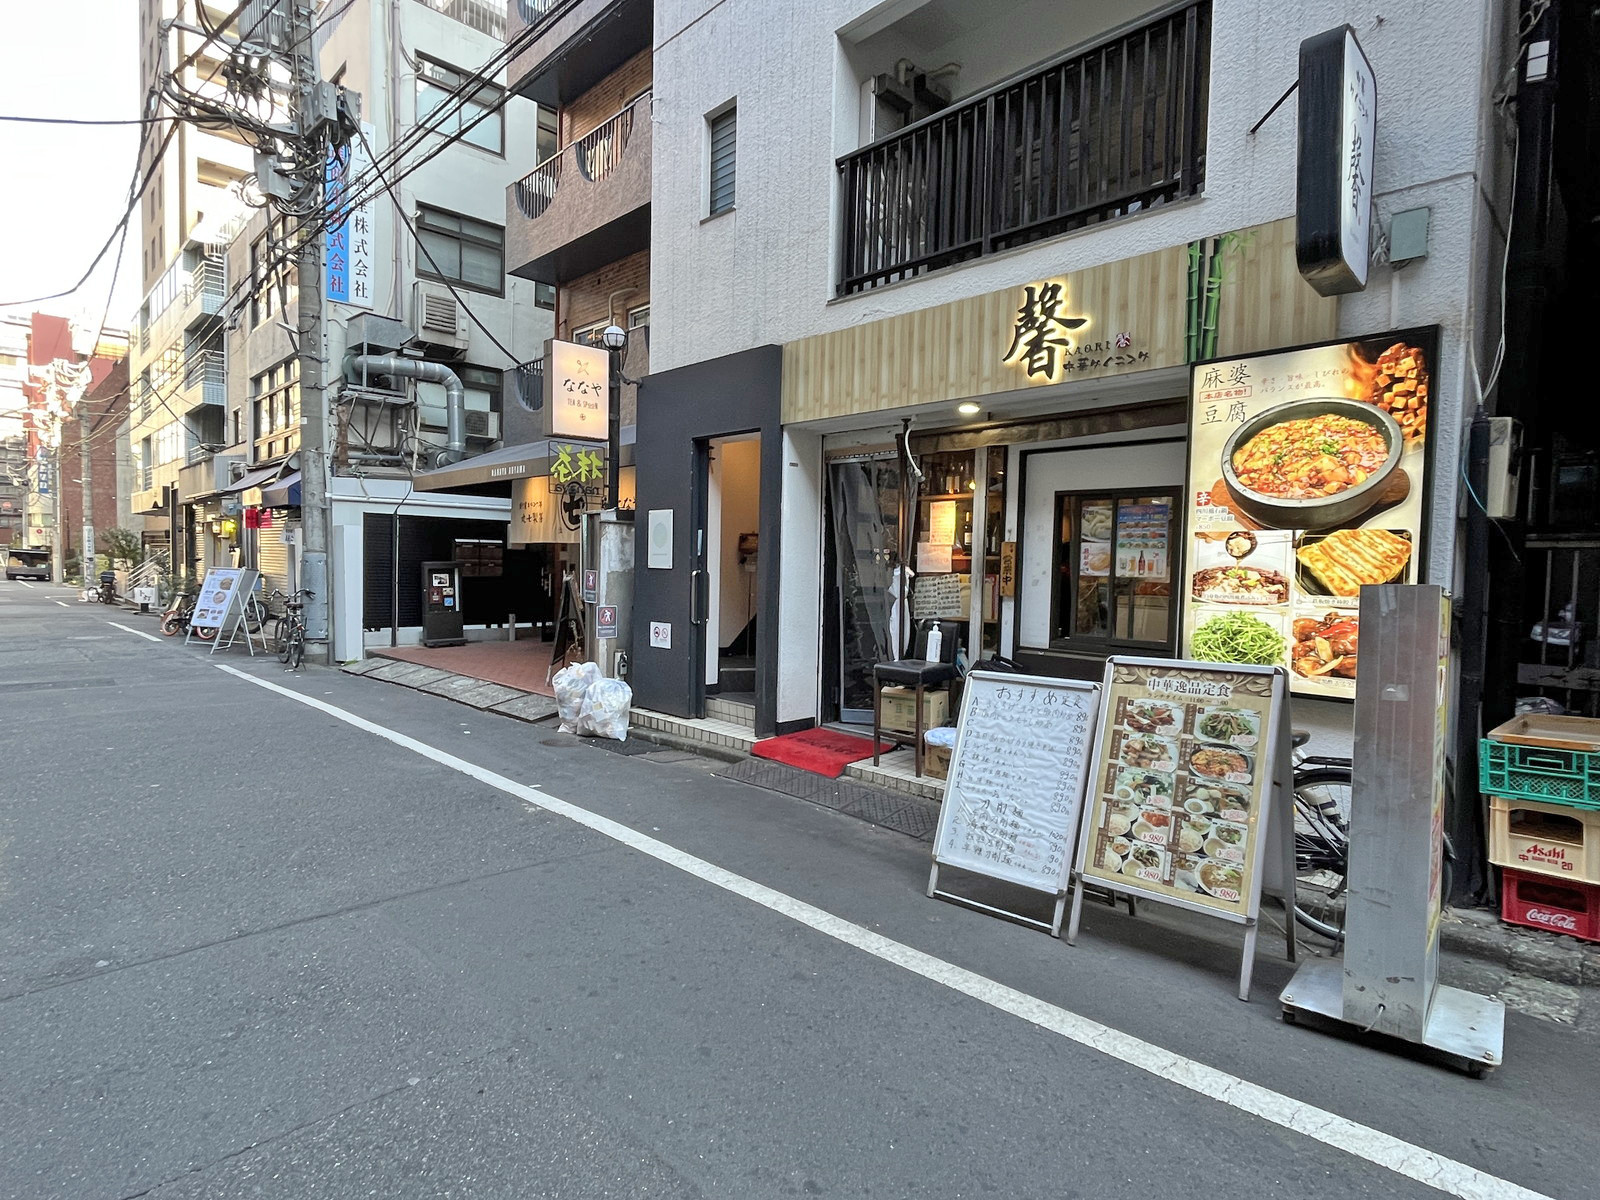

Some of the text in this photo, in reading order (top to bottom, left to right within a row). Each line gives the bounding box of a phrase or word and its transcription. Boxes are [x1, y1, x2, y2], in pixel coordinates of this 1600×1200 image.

[1002, 282, 1087, 380] 馨
[1201, 363, 1251, 390] 麻婆
[562, 378, 602, 397] ななや
[1201, 401, 1248, 426] 豆腐
[1148, 678, 1231, 698] 中華逸品定食
[971, 697, 979, 706] A
[969, 707, 977, 717] B
[966, 719, 974, 727] C
[965, 729, 973, 738] D
[958, 760, 966, 769] G
[957, 770, 964, 779] H
[1526, 844, 1565, 859] Asahi
[1562, 862, 1573, 871] 20
